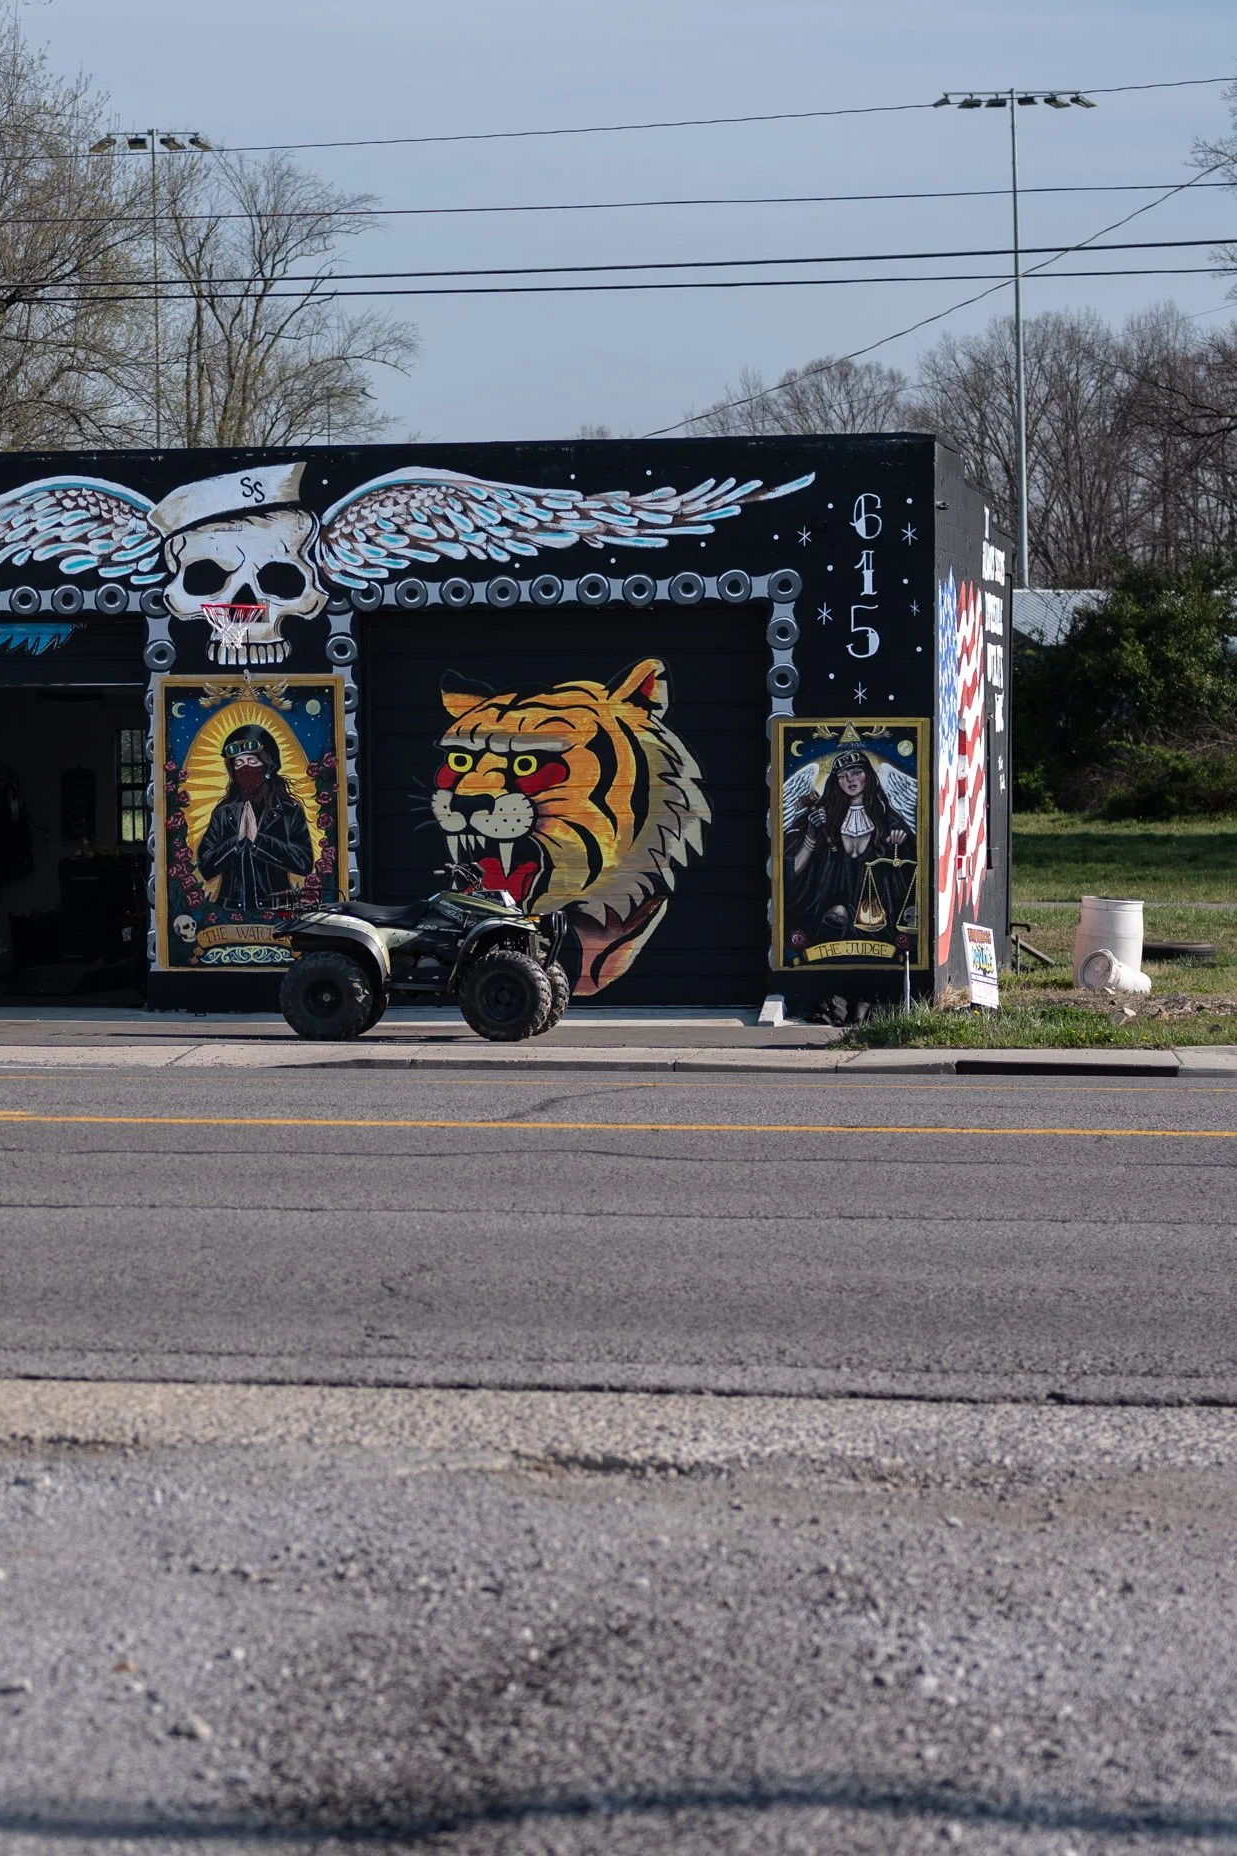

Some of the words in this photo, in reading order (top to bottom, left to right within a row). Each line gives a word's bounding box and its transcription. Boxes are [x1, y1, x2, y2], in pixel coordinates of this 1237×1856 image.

[240, 477, 265, 503] SS
[202, 926, 228, 944] THE
[815, 944, 842, 958] THE
[844, 942, 890, 957] JUDGE
